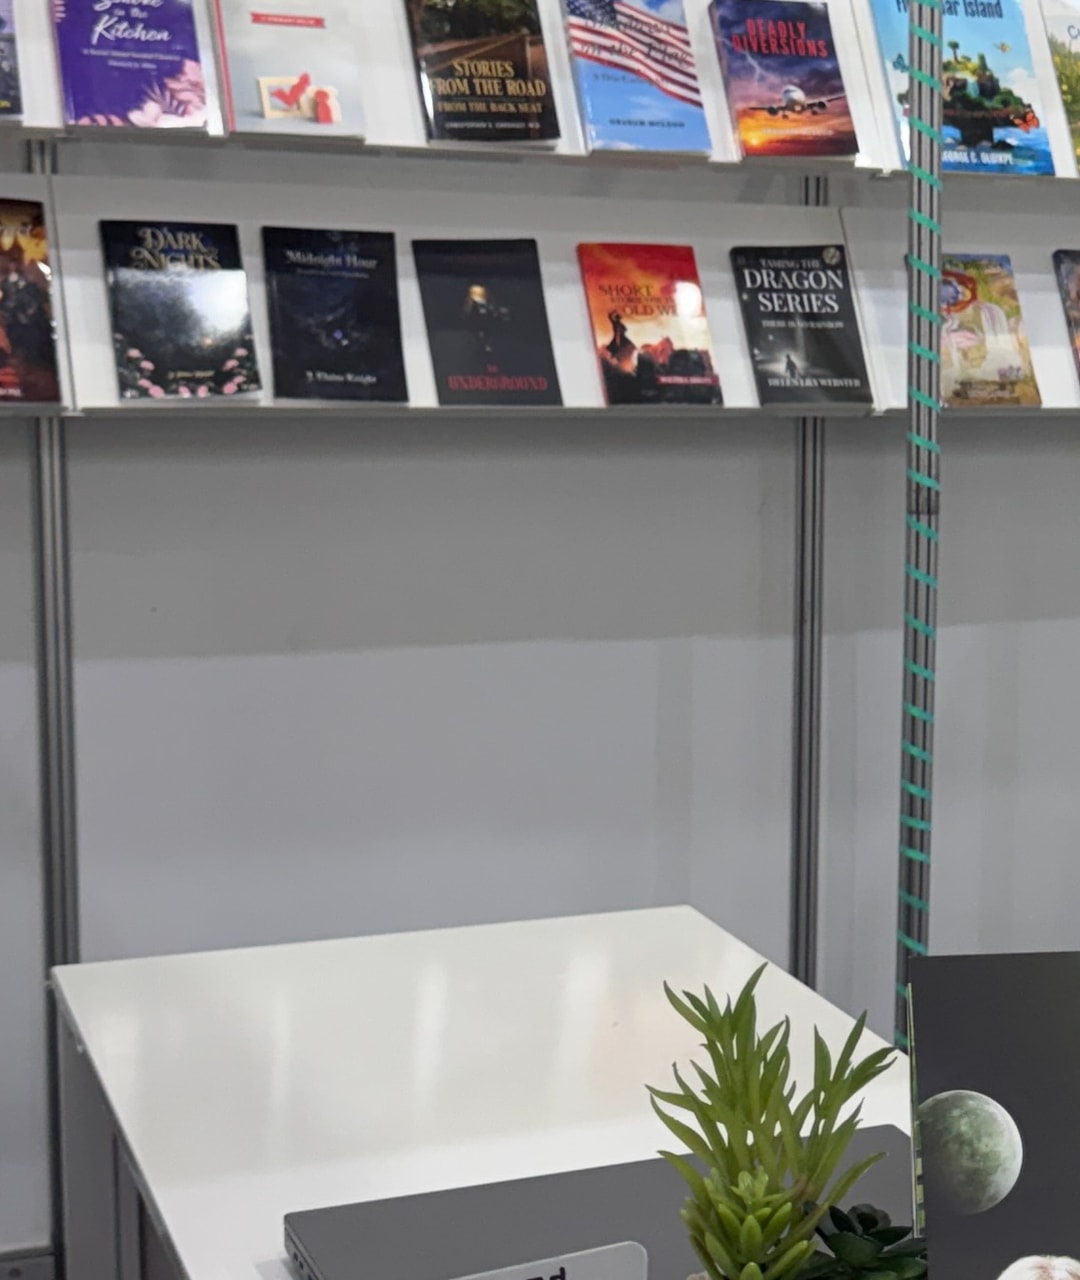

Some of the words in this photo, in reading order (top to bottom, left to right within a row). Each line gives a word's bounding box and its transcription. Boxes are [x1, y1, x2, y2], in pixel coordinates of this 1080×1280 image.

[91, 15, 173, 45] Kitchen
[746, 18, 807, 40] DEADLY
[732, 34, 829, 58] DIVERSIONS
[452, 60, 515, 78] STORIES
[473, 78, 504, 96] THE
[506, 78, 547, 98] ROAD
[138, 227, 208, 252] DARK
[598, 283, 654, 298] SHORT
[743, 269, 845, 291] DRAGON
[757, 292, 841, 314] SERIES
